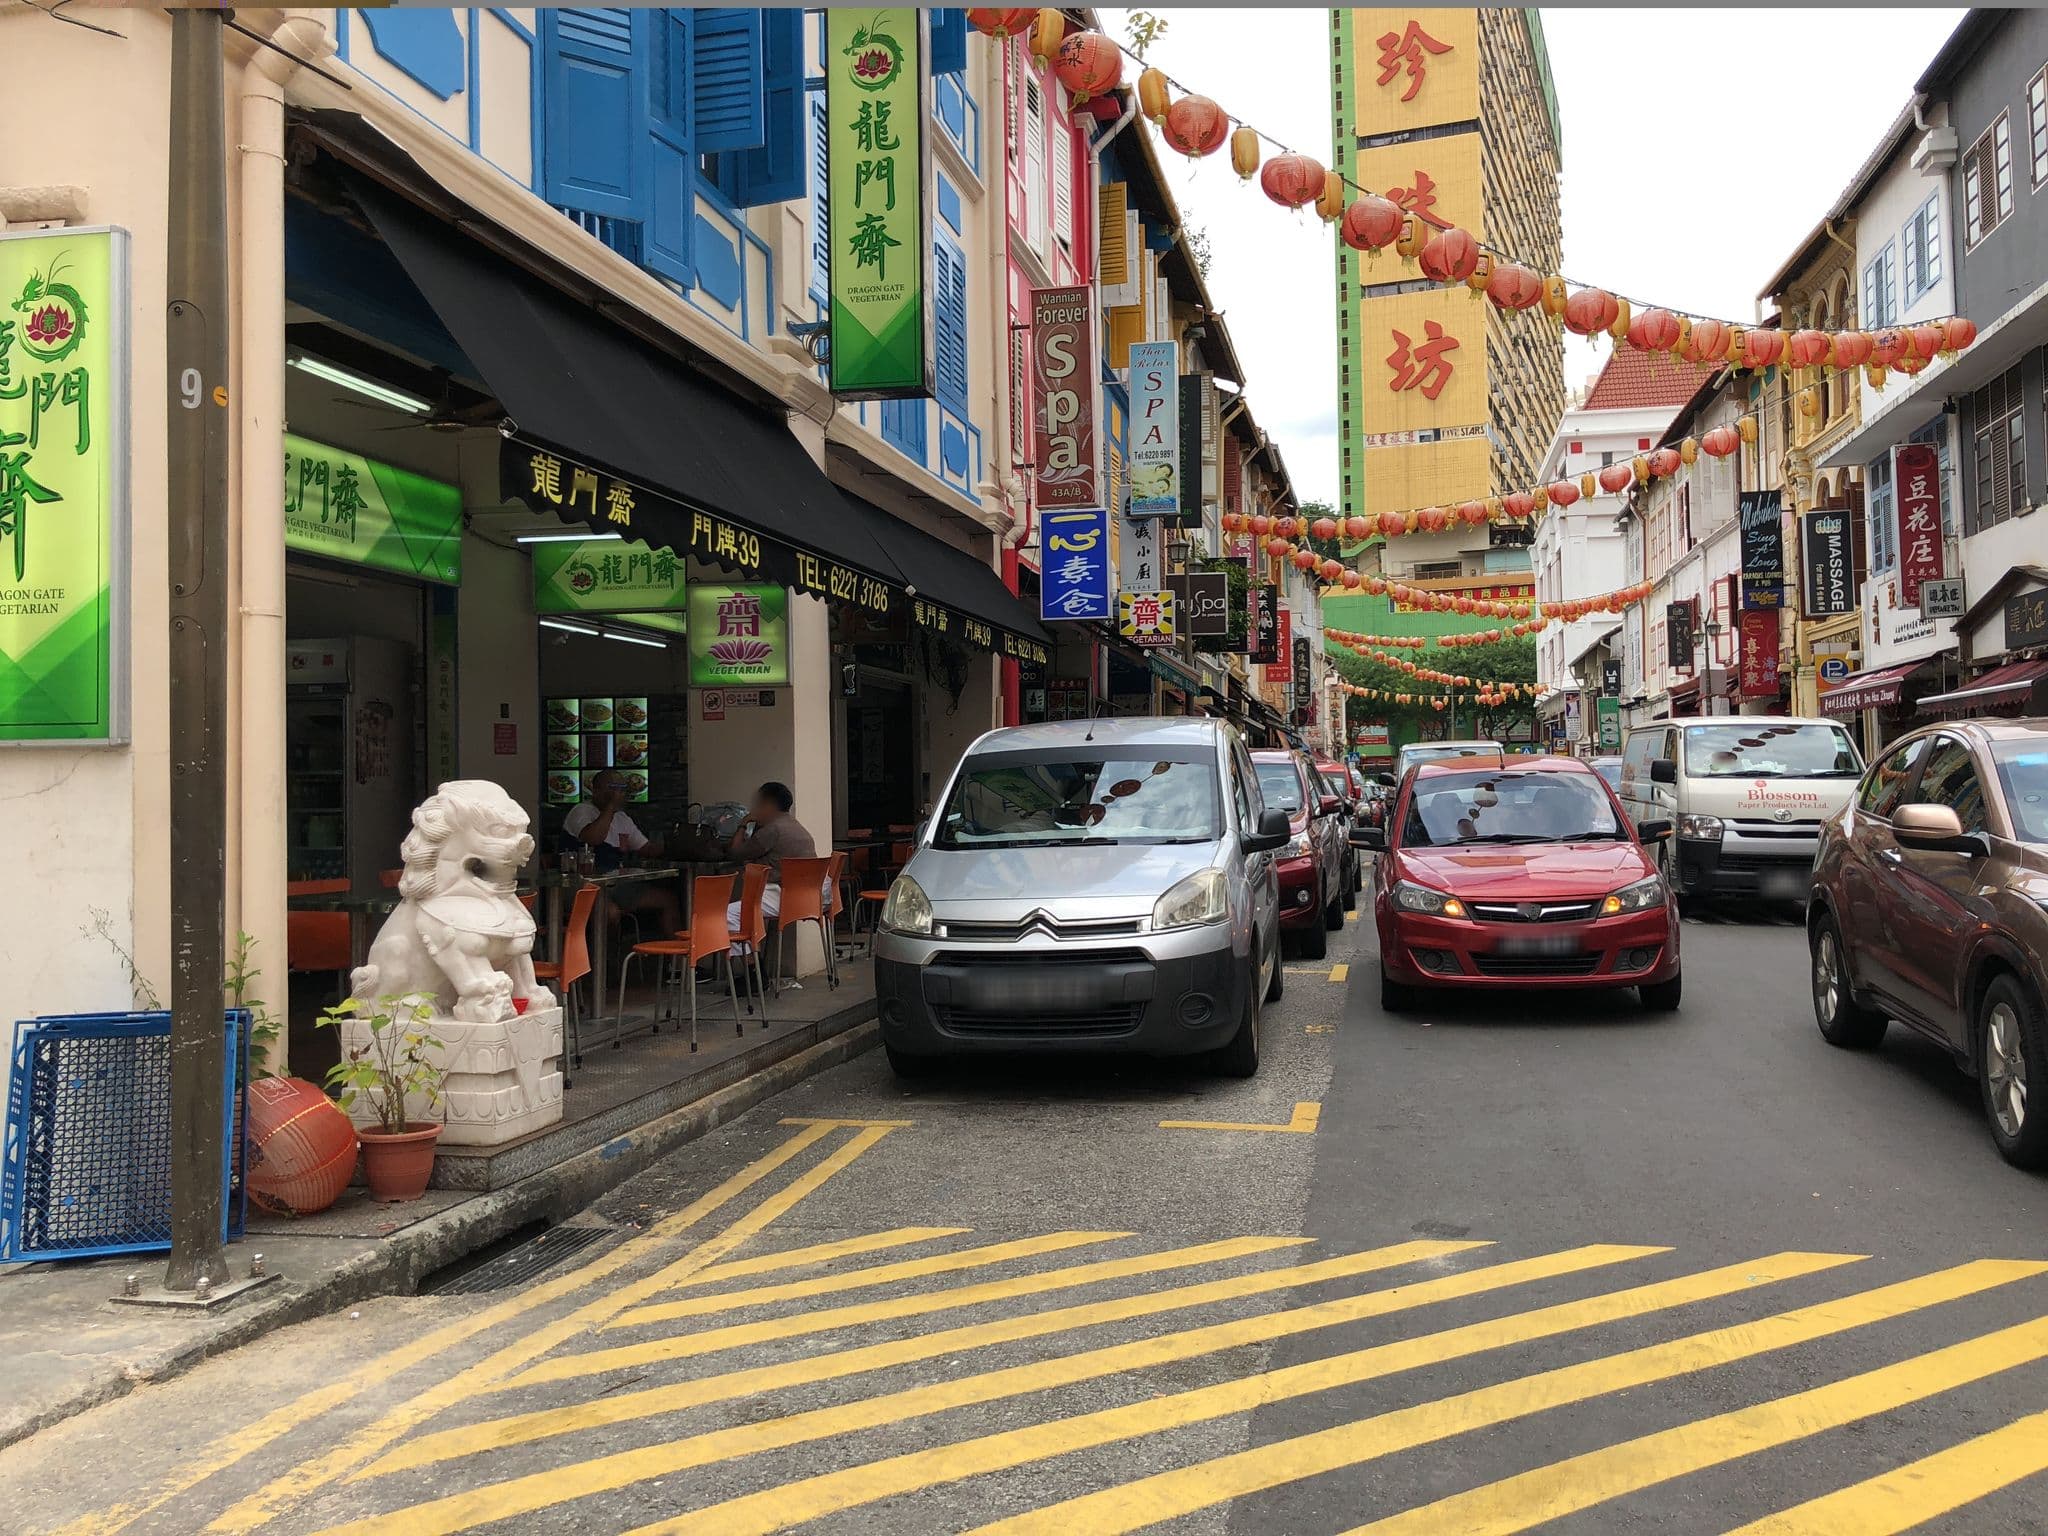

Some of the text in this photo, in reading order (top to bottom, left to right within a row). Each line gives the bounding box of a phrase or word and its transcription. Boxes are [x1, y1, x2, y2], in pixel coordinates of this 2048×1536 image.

[847, 283, 905, 295] DRAGON GATE
[849, 293, 902, 303] VEGETARIAN
[1040, 292, 1082, 305] Wannian
[1036, 306, 1088, 325] Forever
[181, 368, 202, 409] 9
[1045, 333, 1080, 470] Spa
[1142, 371, 1165, 445] SPA
[1461, 425, 1485, 437] STARS
[1051, 488, 1082, 498] 43A/B
[1905, 475, 1937, 565] 豆花庄
[1747, 531, 1777, 546] Sing
[1746, 556, 1778, 570] Long
[1829, 535, 1844, 611] MASSAGE
[796, 553, 889, 612] TEL: 6221 3186
[33, 588, 65, 600] GATE
[1128, 634, 1171, 645] GETARIAN
[709, 665, 771, 675] VEGETARIAN
[1748, 789, 1818, 801] Blossom
[1737, 801, 1760, 809] Paper
[1762, 801, 1797, 809] Products
